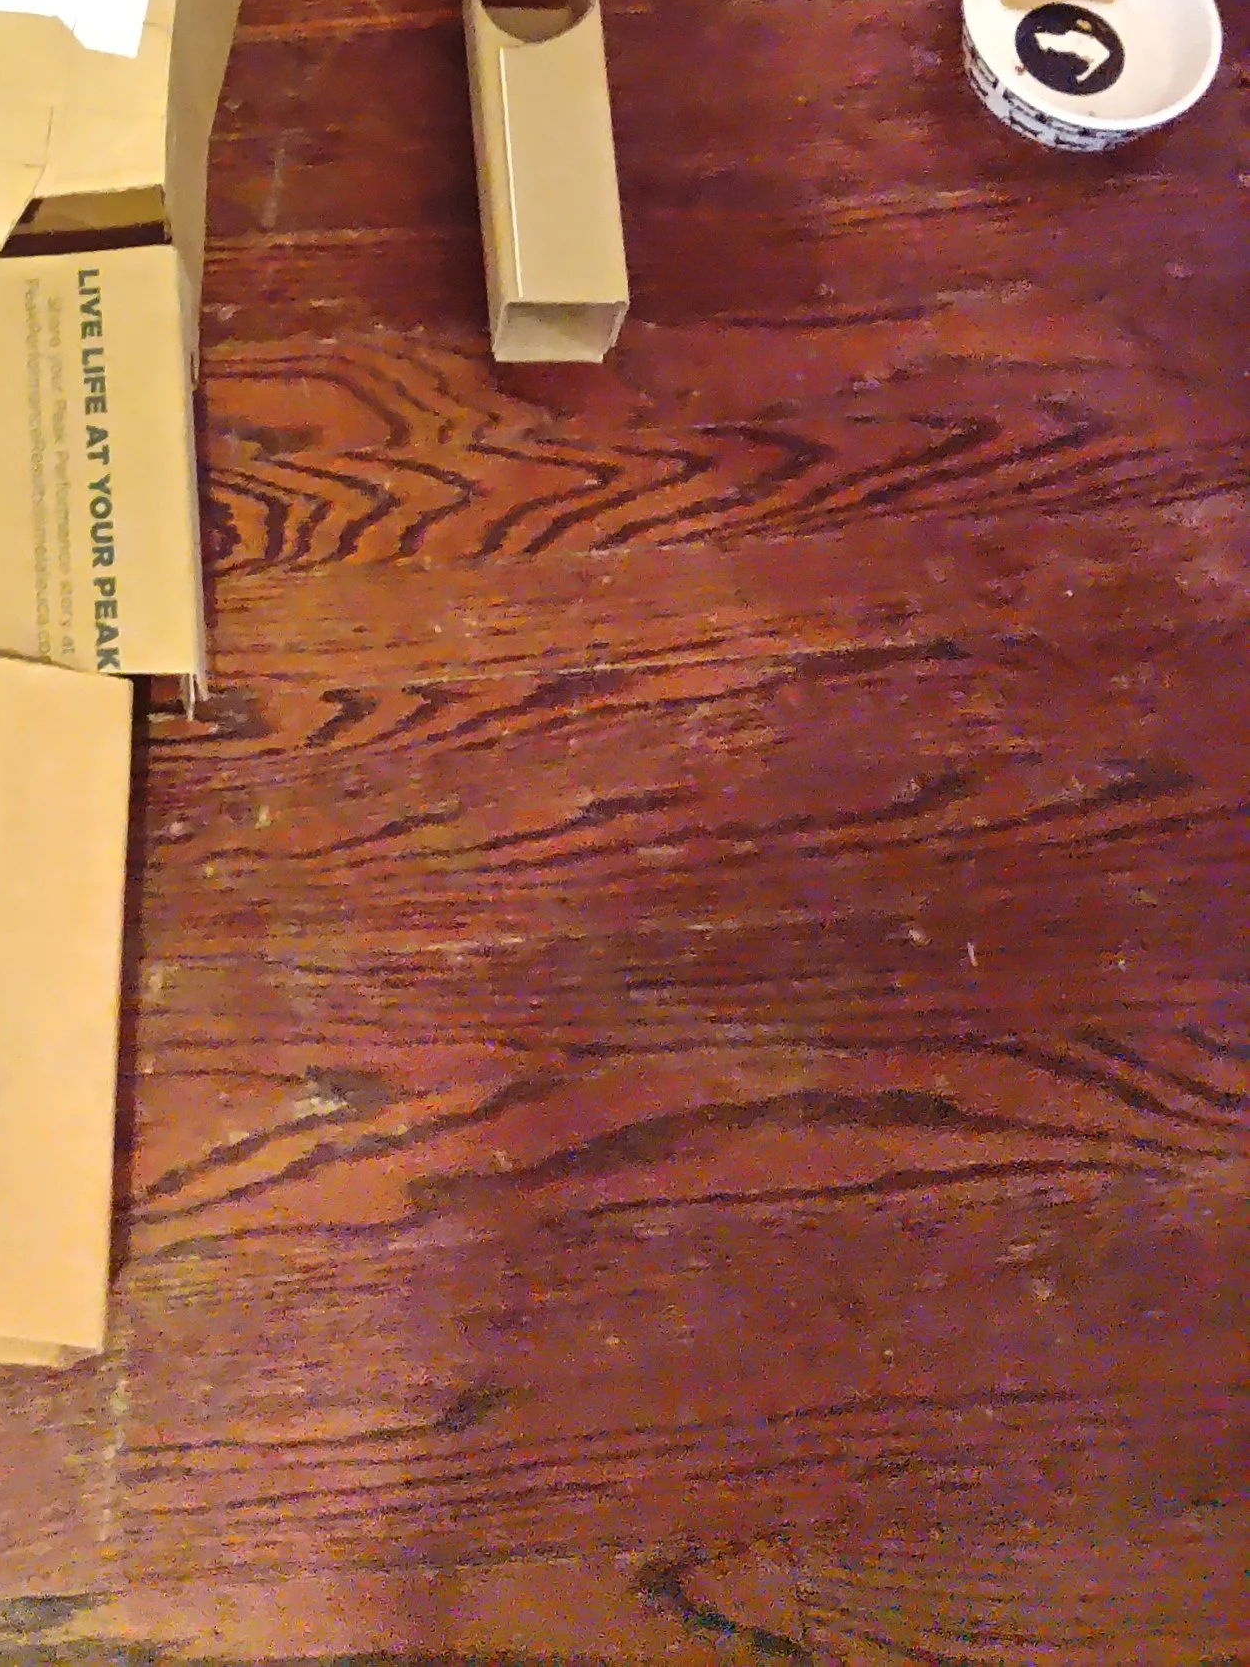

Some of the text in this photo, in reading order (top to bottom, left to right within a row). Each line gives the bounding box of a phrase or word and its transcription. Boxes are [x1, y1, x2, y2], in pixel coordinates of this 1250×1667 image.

[47, 294, 77, 655] Share your Peak Performance story at
[77, 268, 122, 671] LIVE LIFE AT YOUR PEAK
